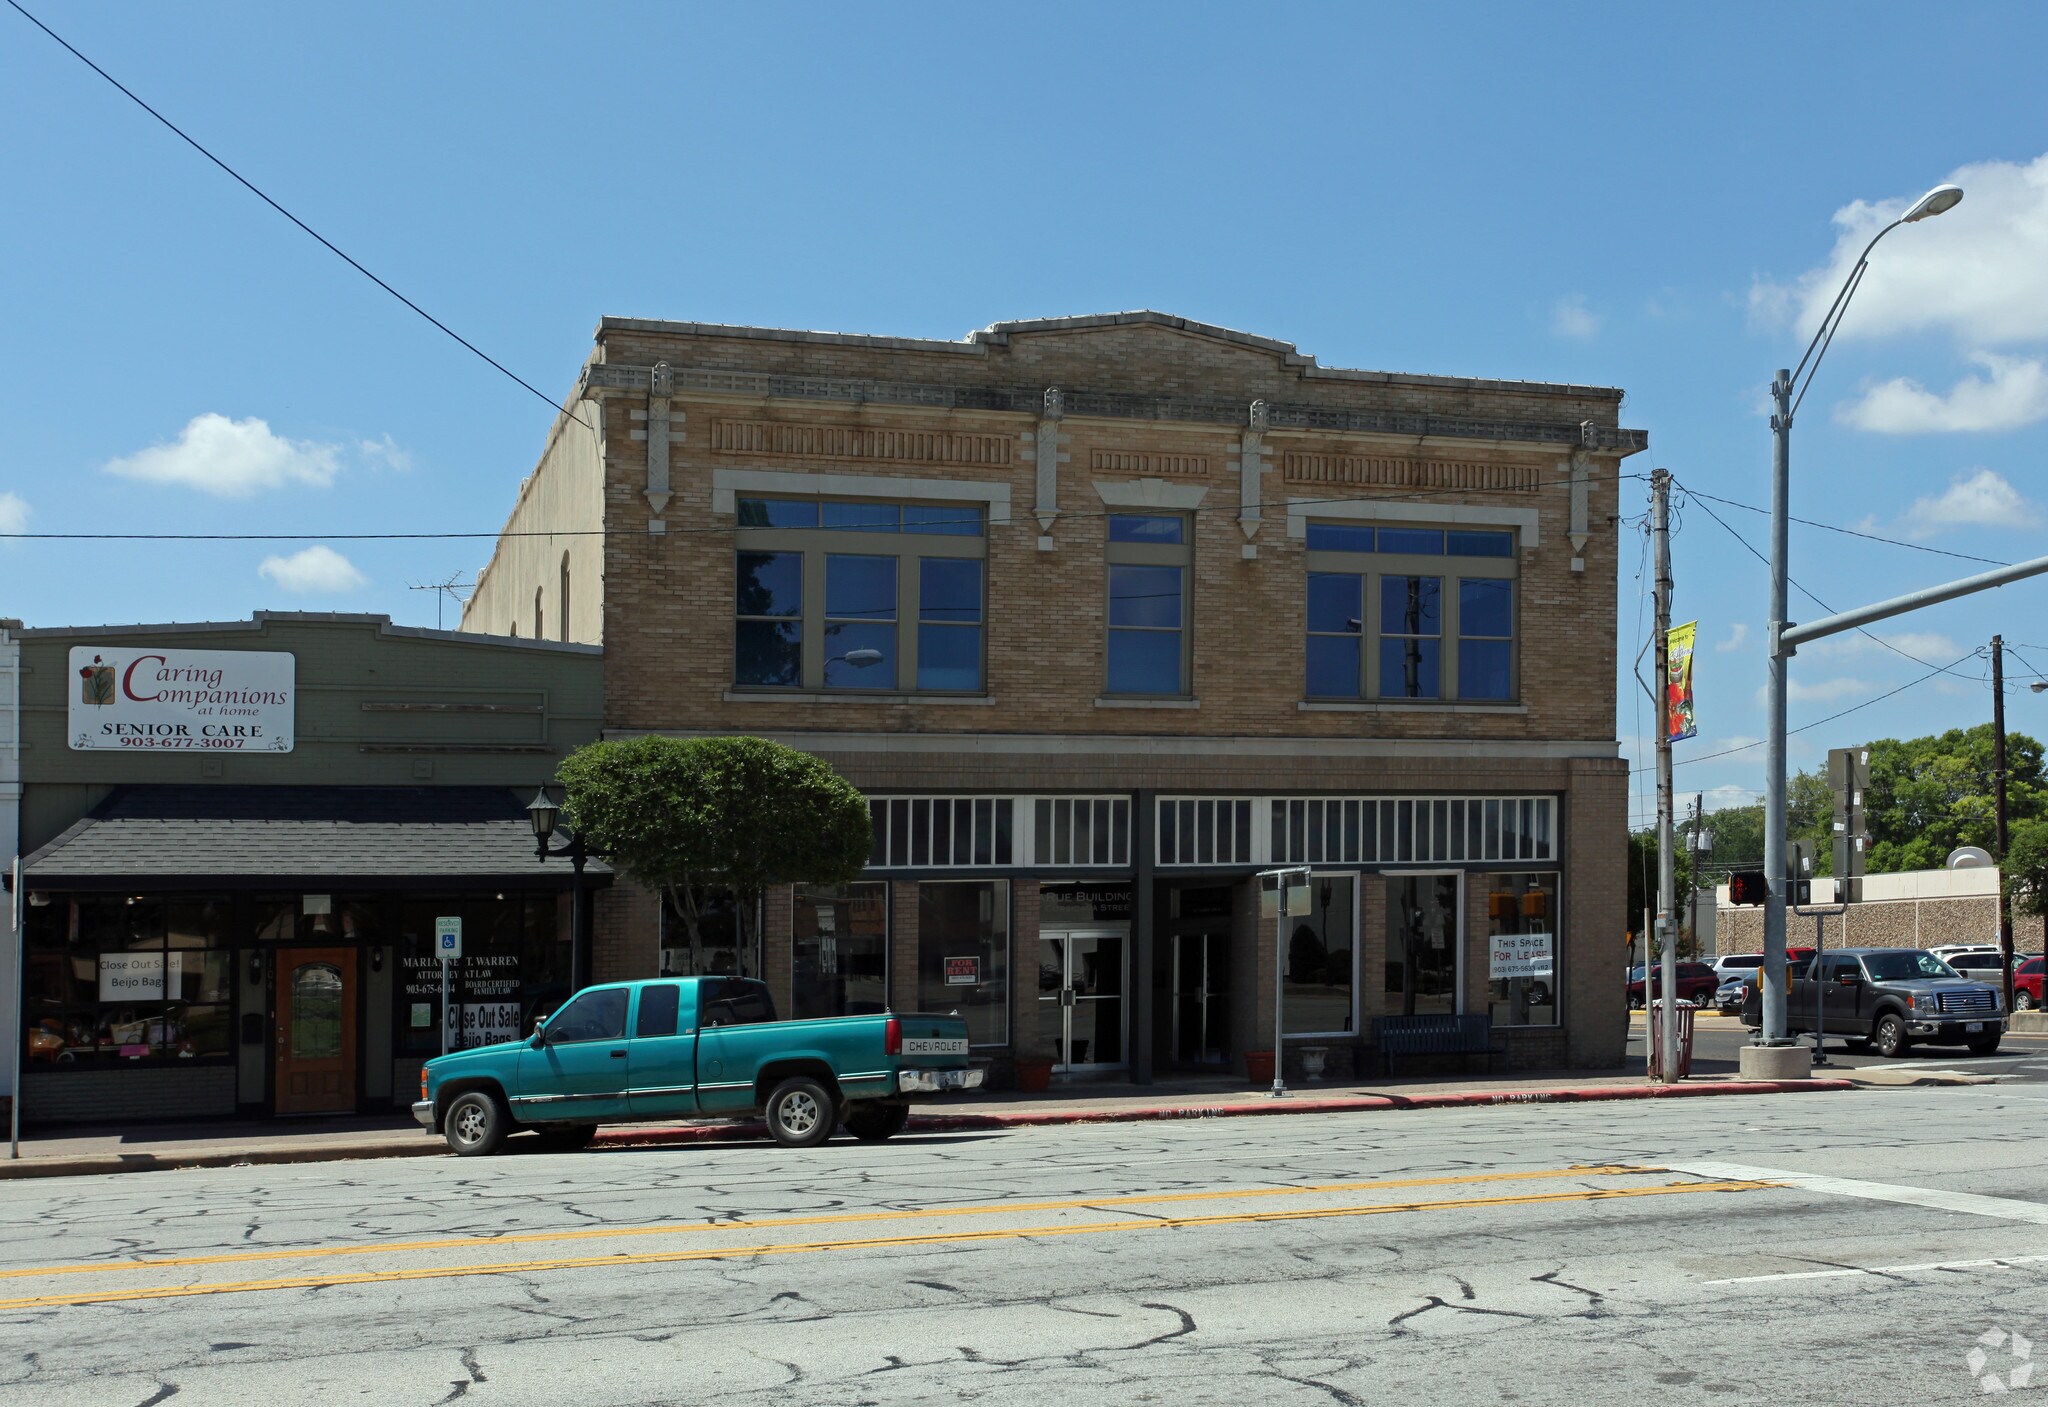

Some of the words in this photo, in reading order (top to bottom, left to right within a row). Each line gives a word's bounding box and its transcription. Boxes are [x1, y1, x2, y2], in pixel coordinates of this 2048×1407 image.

[122, 655, 223, 701] Caring
[198, 705, 213, 716] at
[219, 704, 260, 717] home
[100, 722, 191, 736] SENIOR
[201, 724, 264, 738] CARE
[120, 736, 245, 749] 903-677-3007
[100, 960, 128, 970] Close
[131, 960, 151, 969] Out
[476, 956, 519, 966] WARREN
[951, 959, 973, 967] FOR
[416, 970, 459, 980] ATTOREY
[464, 970, 475, 979] AT
[475, 969, 493, 978] LAW
[946, 966, 977, 975] RENT
[111, 977, 139, 989] Beijo
[465, 980, 487, 989] BOARD
[487, 979, 521, 988] CERTIFIED
[473, 987, 497, 996] FAMILY
[498, 986, 512, 995] LAW
[448, 1005, 476, 1029] Clse
[478, 1005, 496, 1028] Out
[498, 1005, 520, 1028] Sale
[909, 1041, 963, 1052] CHEVROLET
[1158, 1109, 1172, 1118] NO
[1178, 1107, 1224, 1117] PARKING
